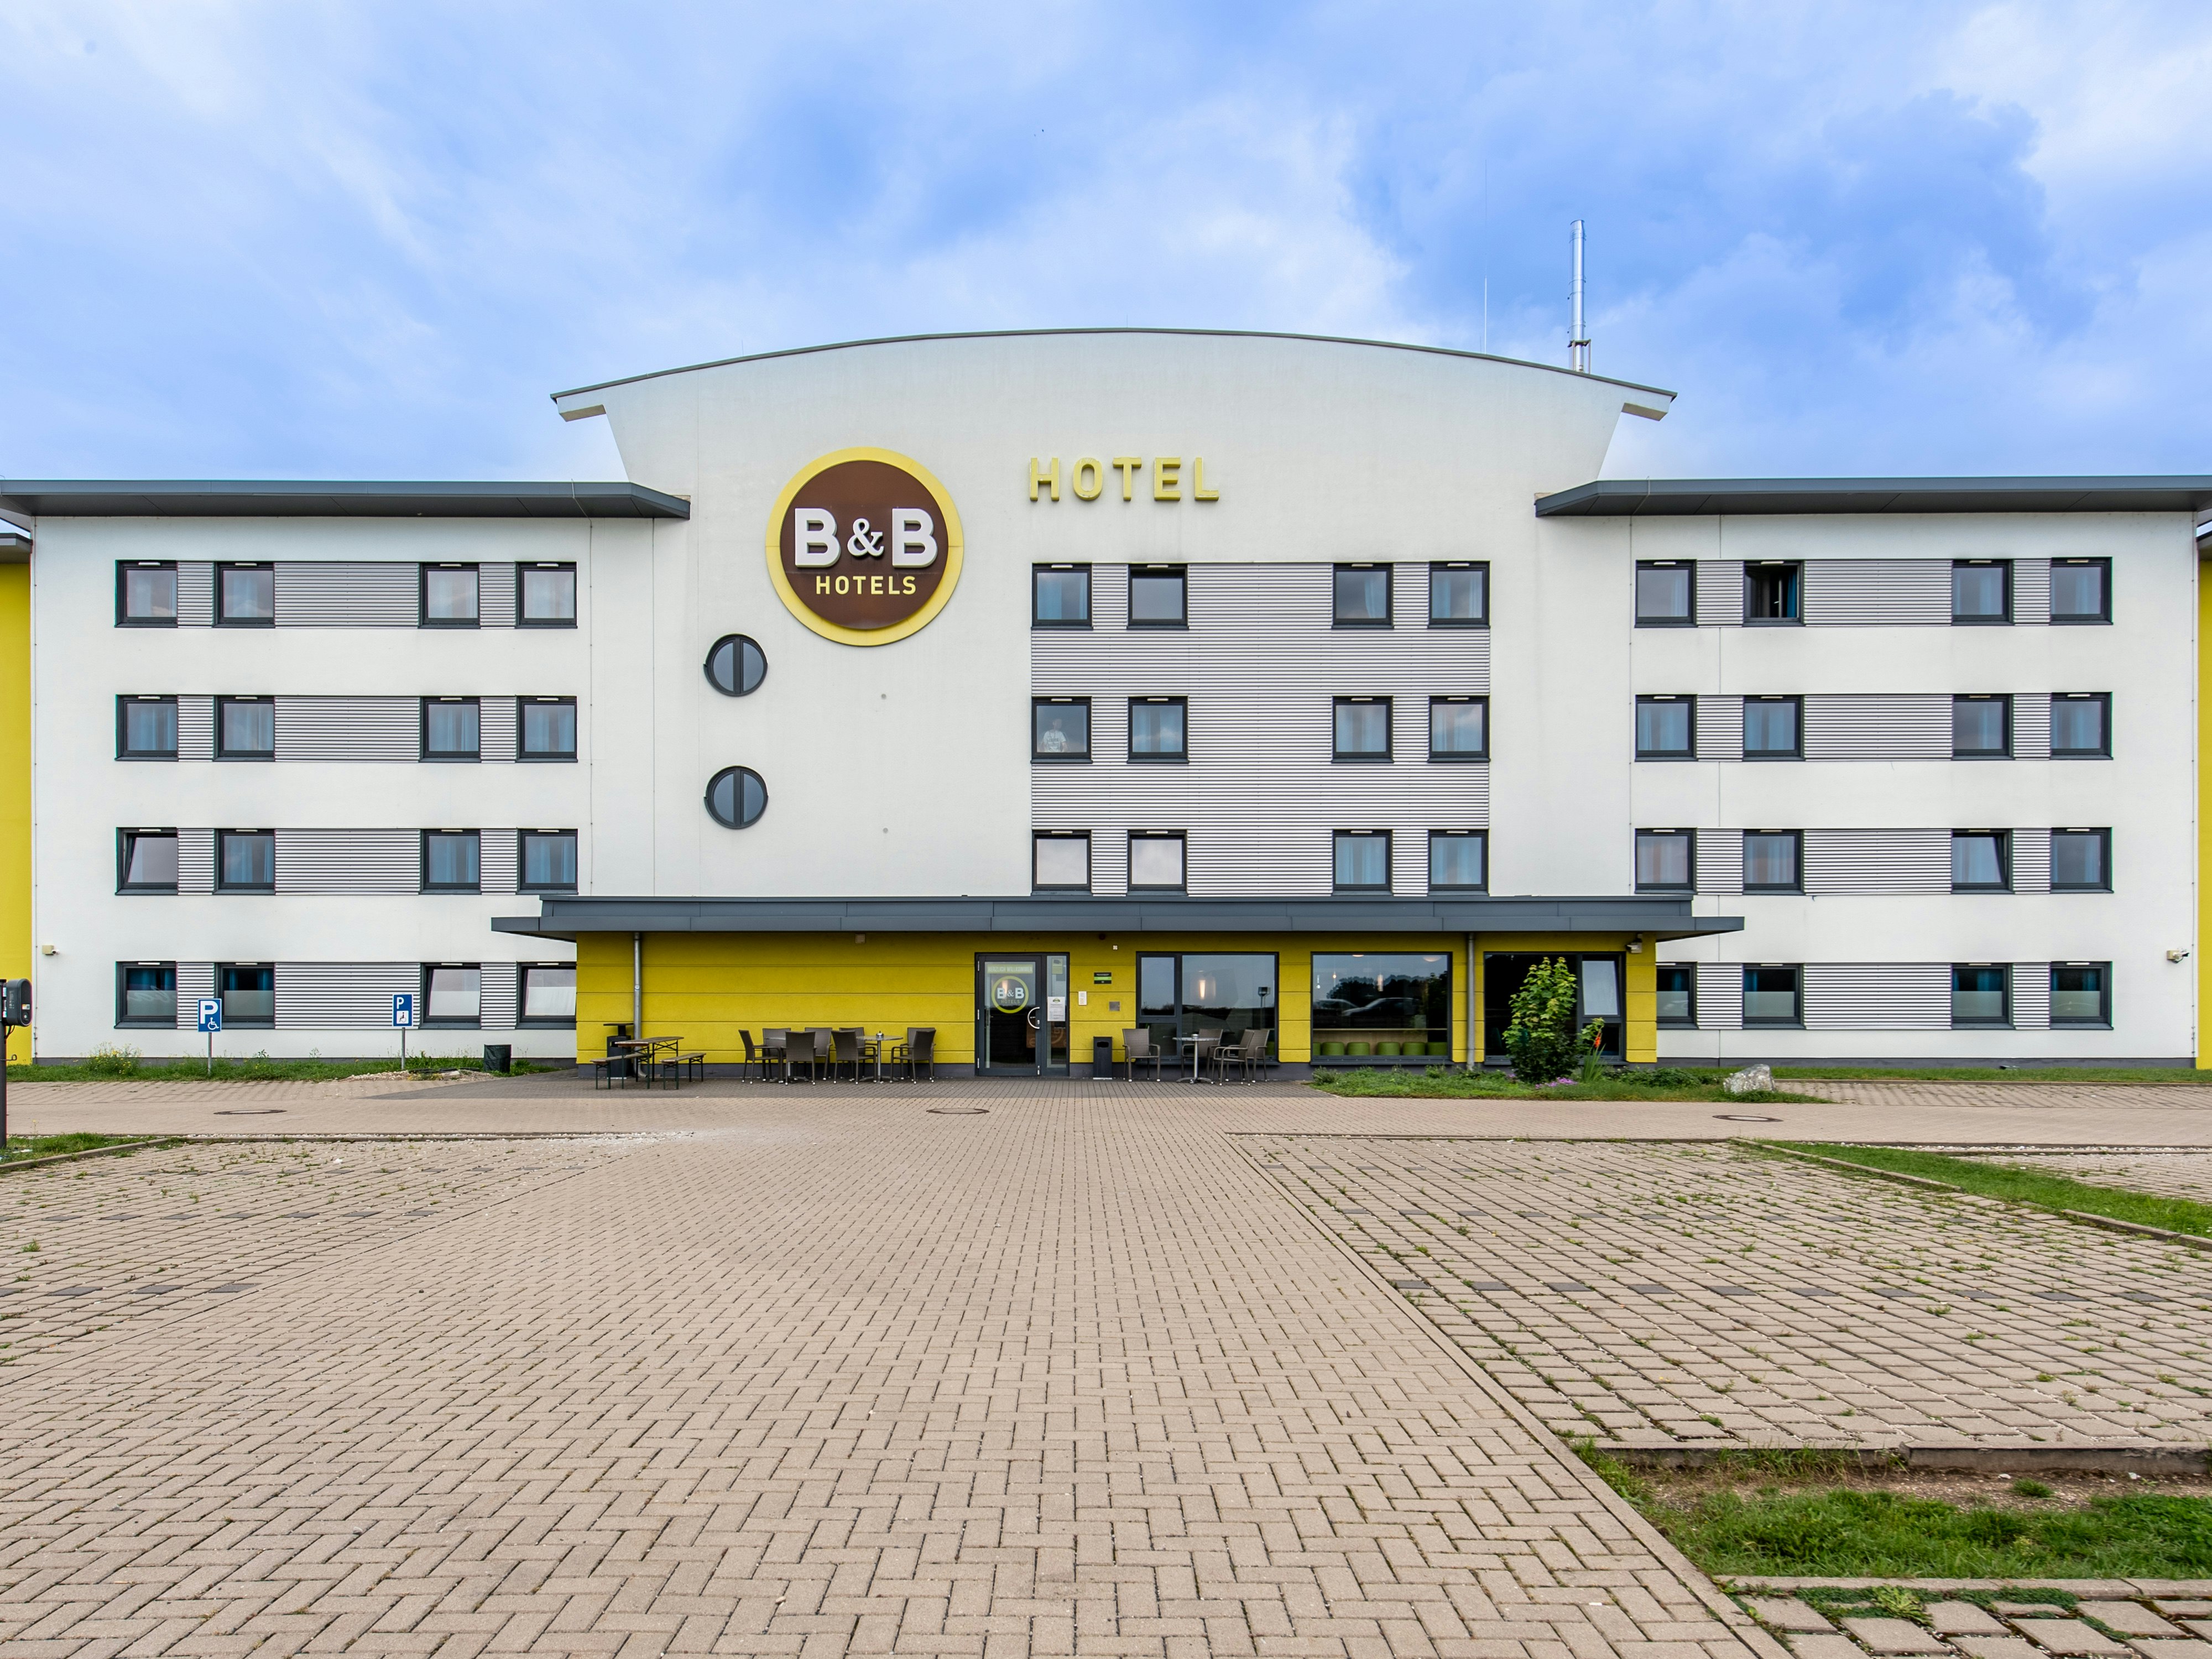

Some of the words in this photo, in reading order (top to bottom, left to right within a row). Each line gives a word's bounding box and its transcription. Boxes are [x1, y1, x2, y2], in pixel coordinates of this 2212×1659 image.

[1029, 457, 1219, 502] HOTEL
[795, 508, 938, 568] B&B
[816, 575, 916, 595] HOTELS
[397, 997, 404, 1009] P
[997, 987, 1024, 999] B&B
[200, 1000, 218, 1024] P
